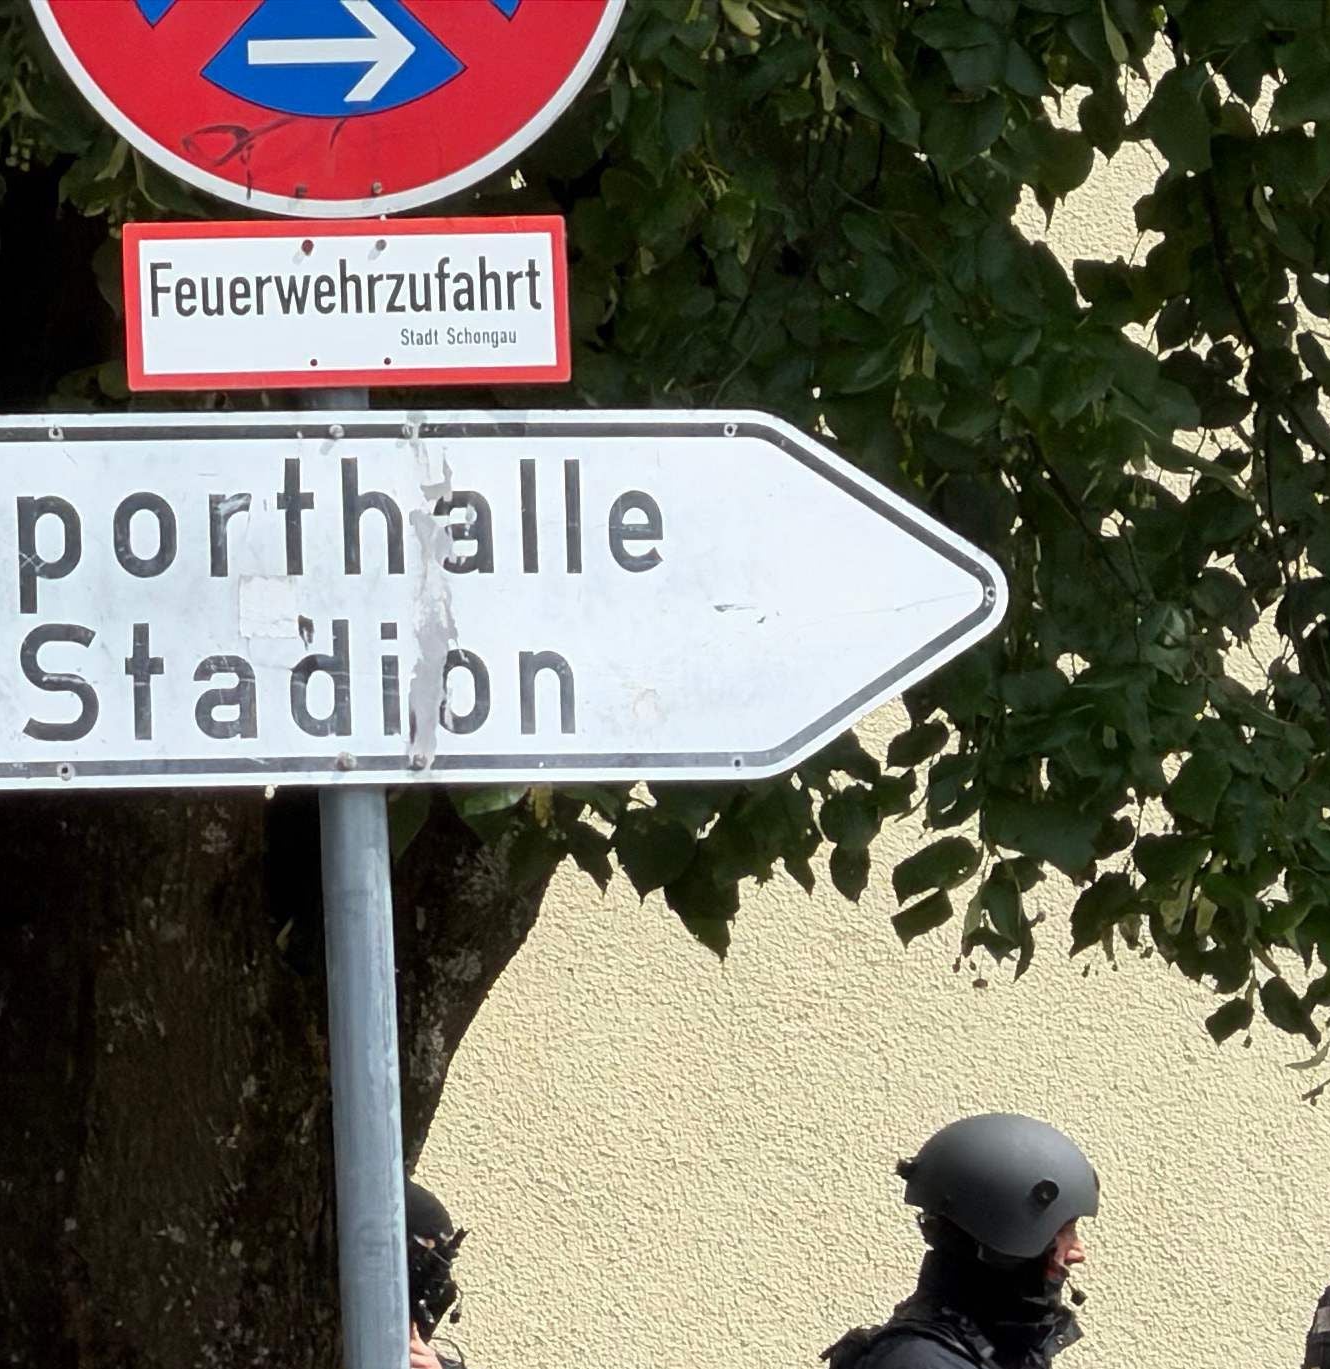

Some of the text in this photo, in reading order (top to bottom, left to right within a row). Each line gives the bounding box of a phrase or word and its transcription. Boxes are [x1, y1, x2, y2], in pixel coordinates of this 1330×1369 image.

[149, 256, 542, 318] Feuerwehrzufahrt
[400, 326, 518, 349] Stadt Schongau
[19, 618, 577, 742] Stadion
